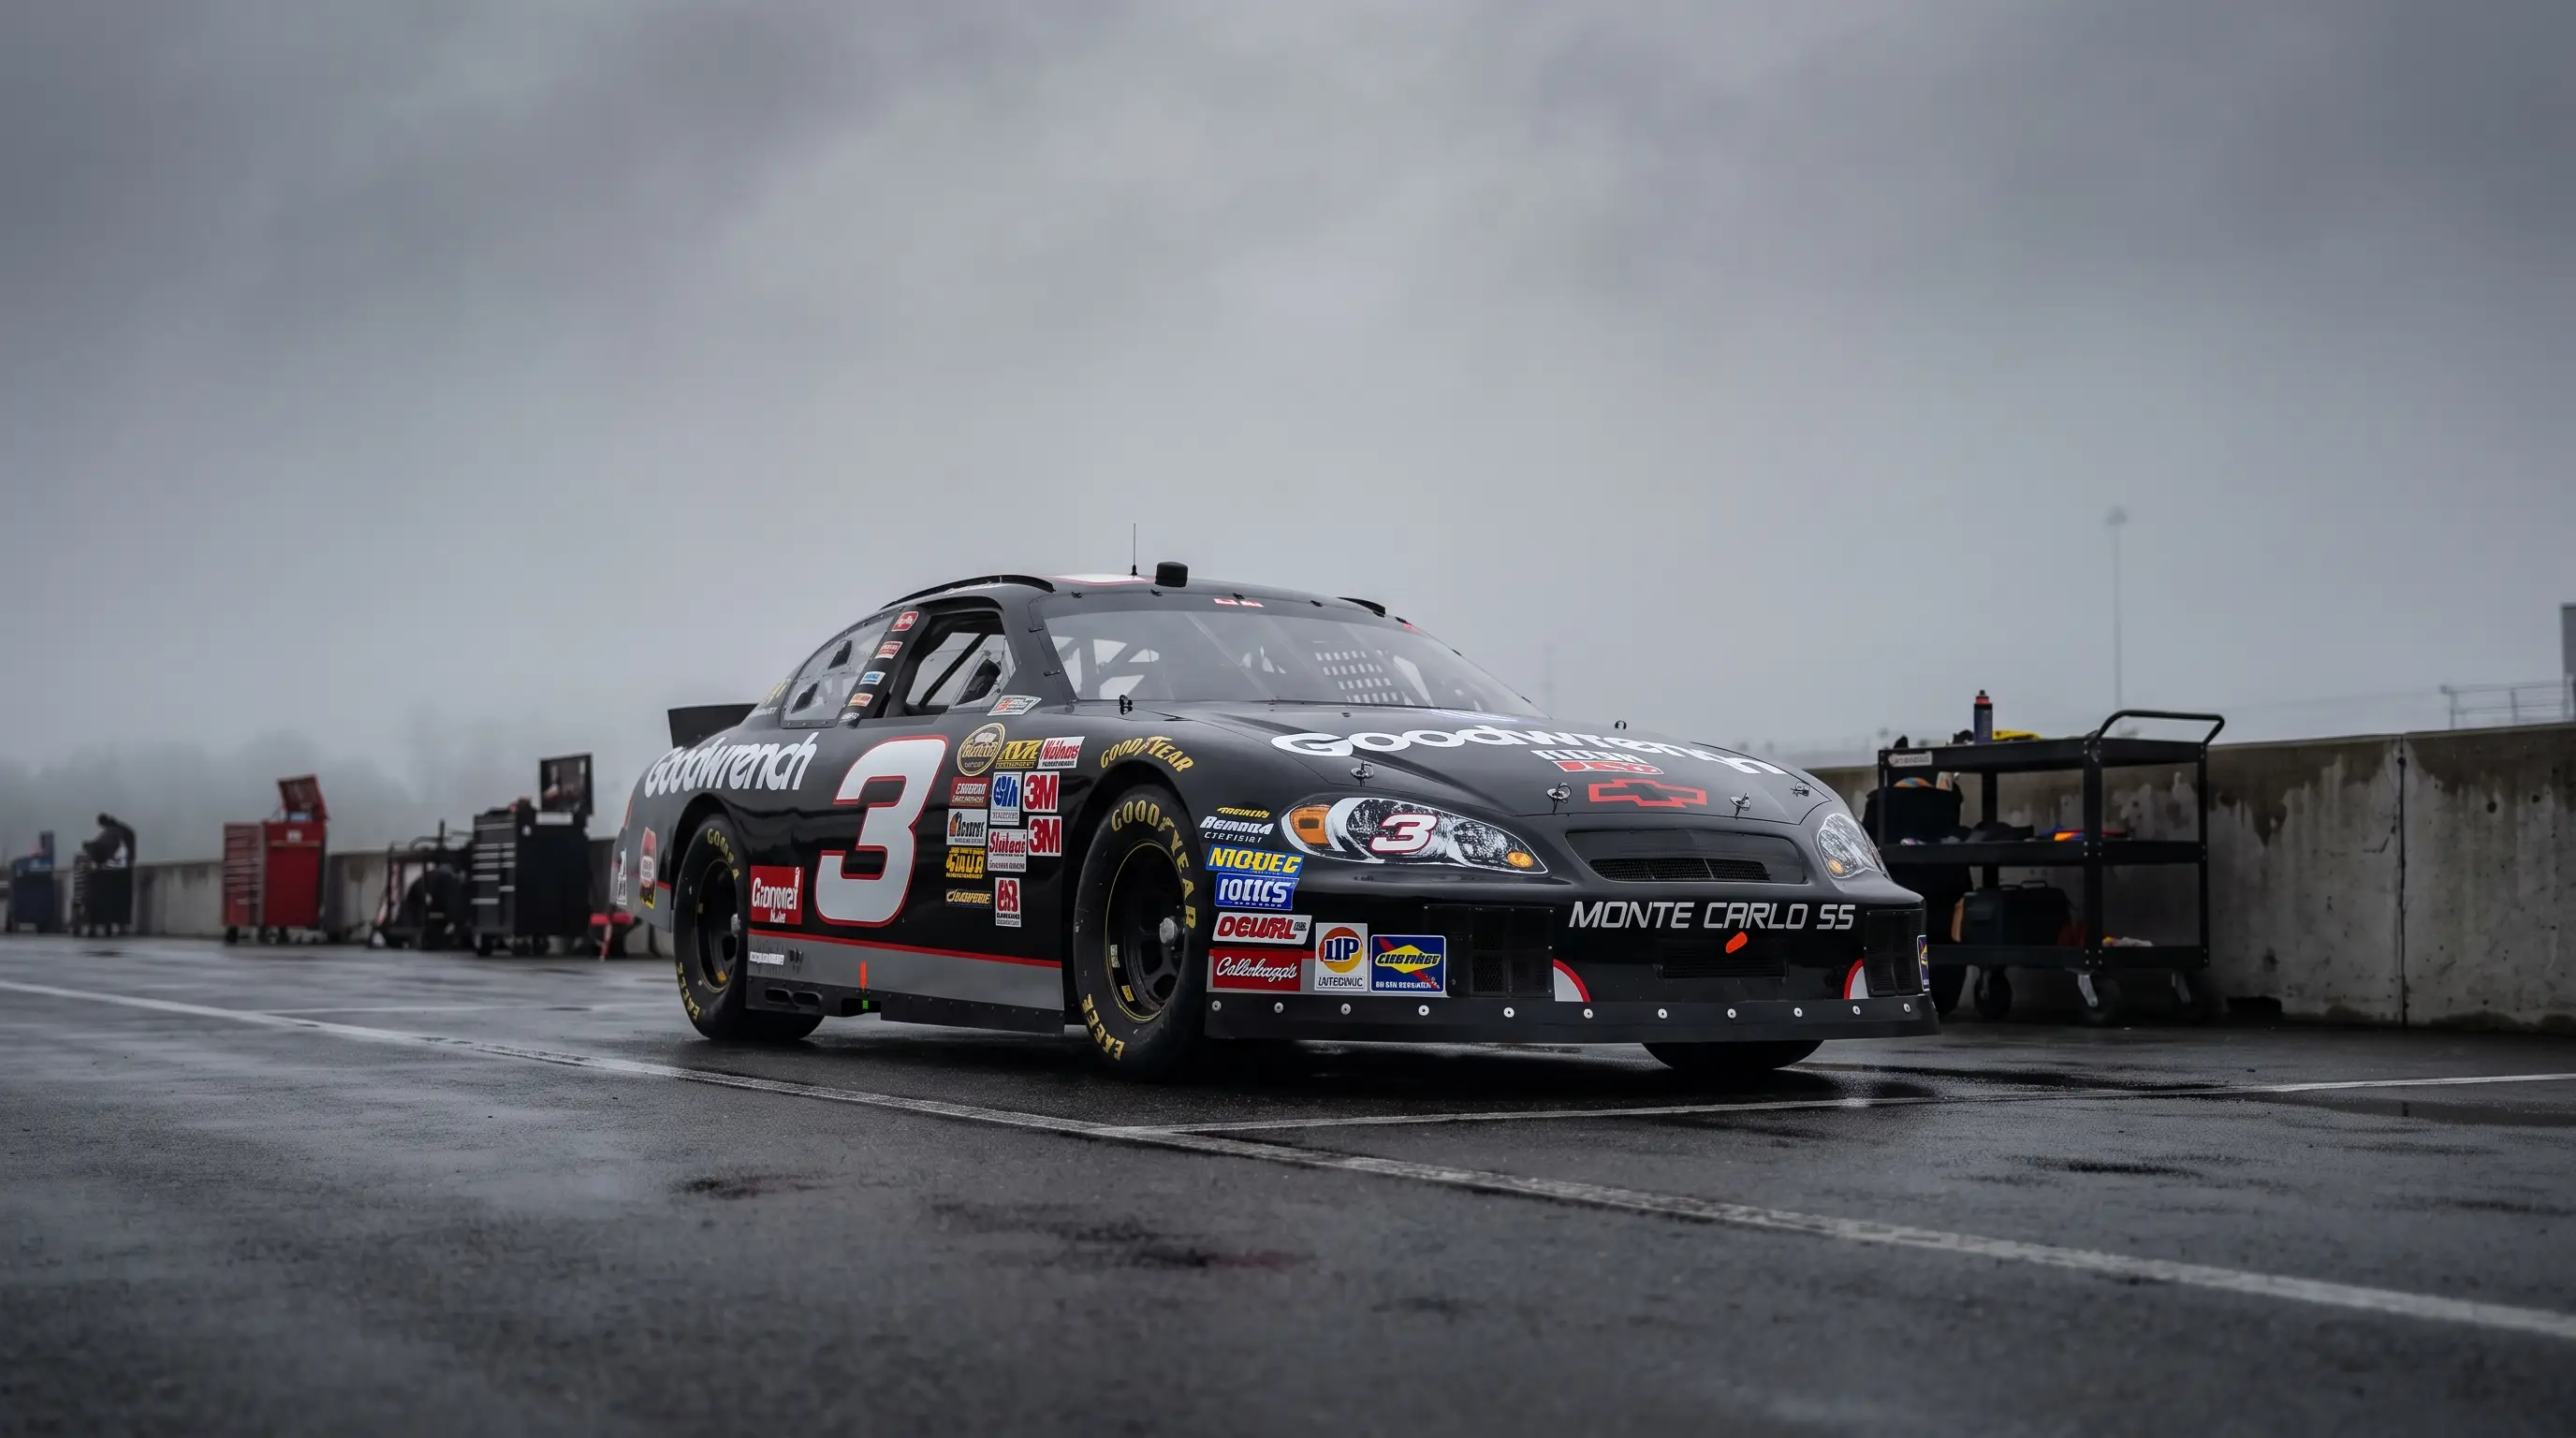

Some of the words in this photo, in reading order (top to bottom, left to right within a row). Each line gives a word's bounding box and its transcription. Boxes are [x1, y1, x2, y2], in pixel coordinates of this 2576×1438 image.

[645, 732, 820, 799] Goodwrench
[1024, 774, 1059, 811] 3M
[814, 735, 949, 928] 3
[1029, 818, 1061, 854] 3M
[1369, 812, 1439, 854] 3
[1568, 901, 1695, 929] MONTE
[1703, 902, 1808, 930] CARLO
